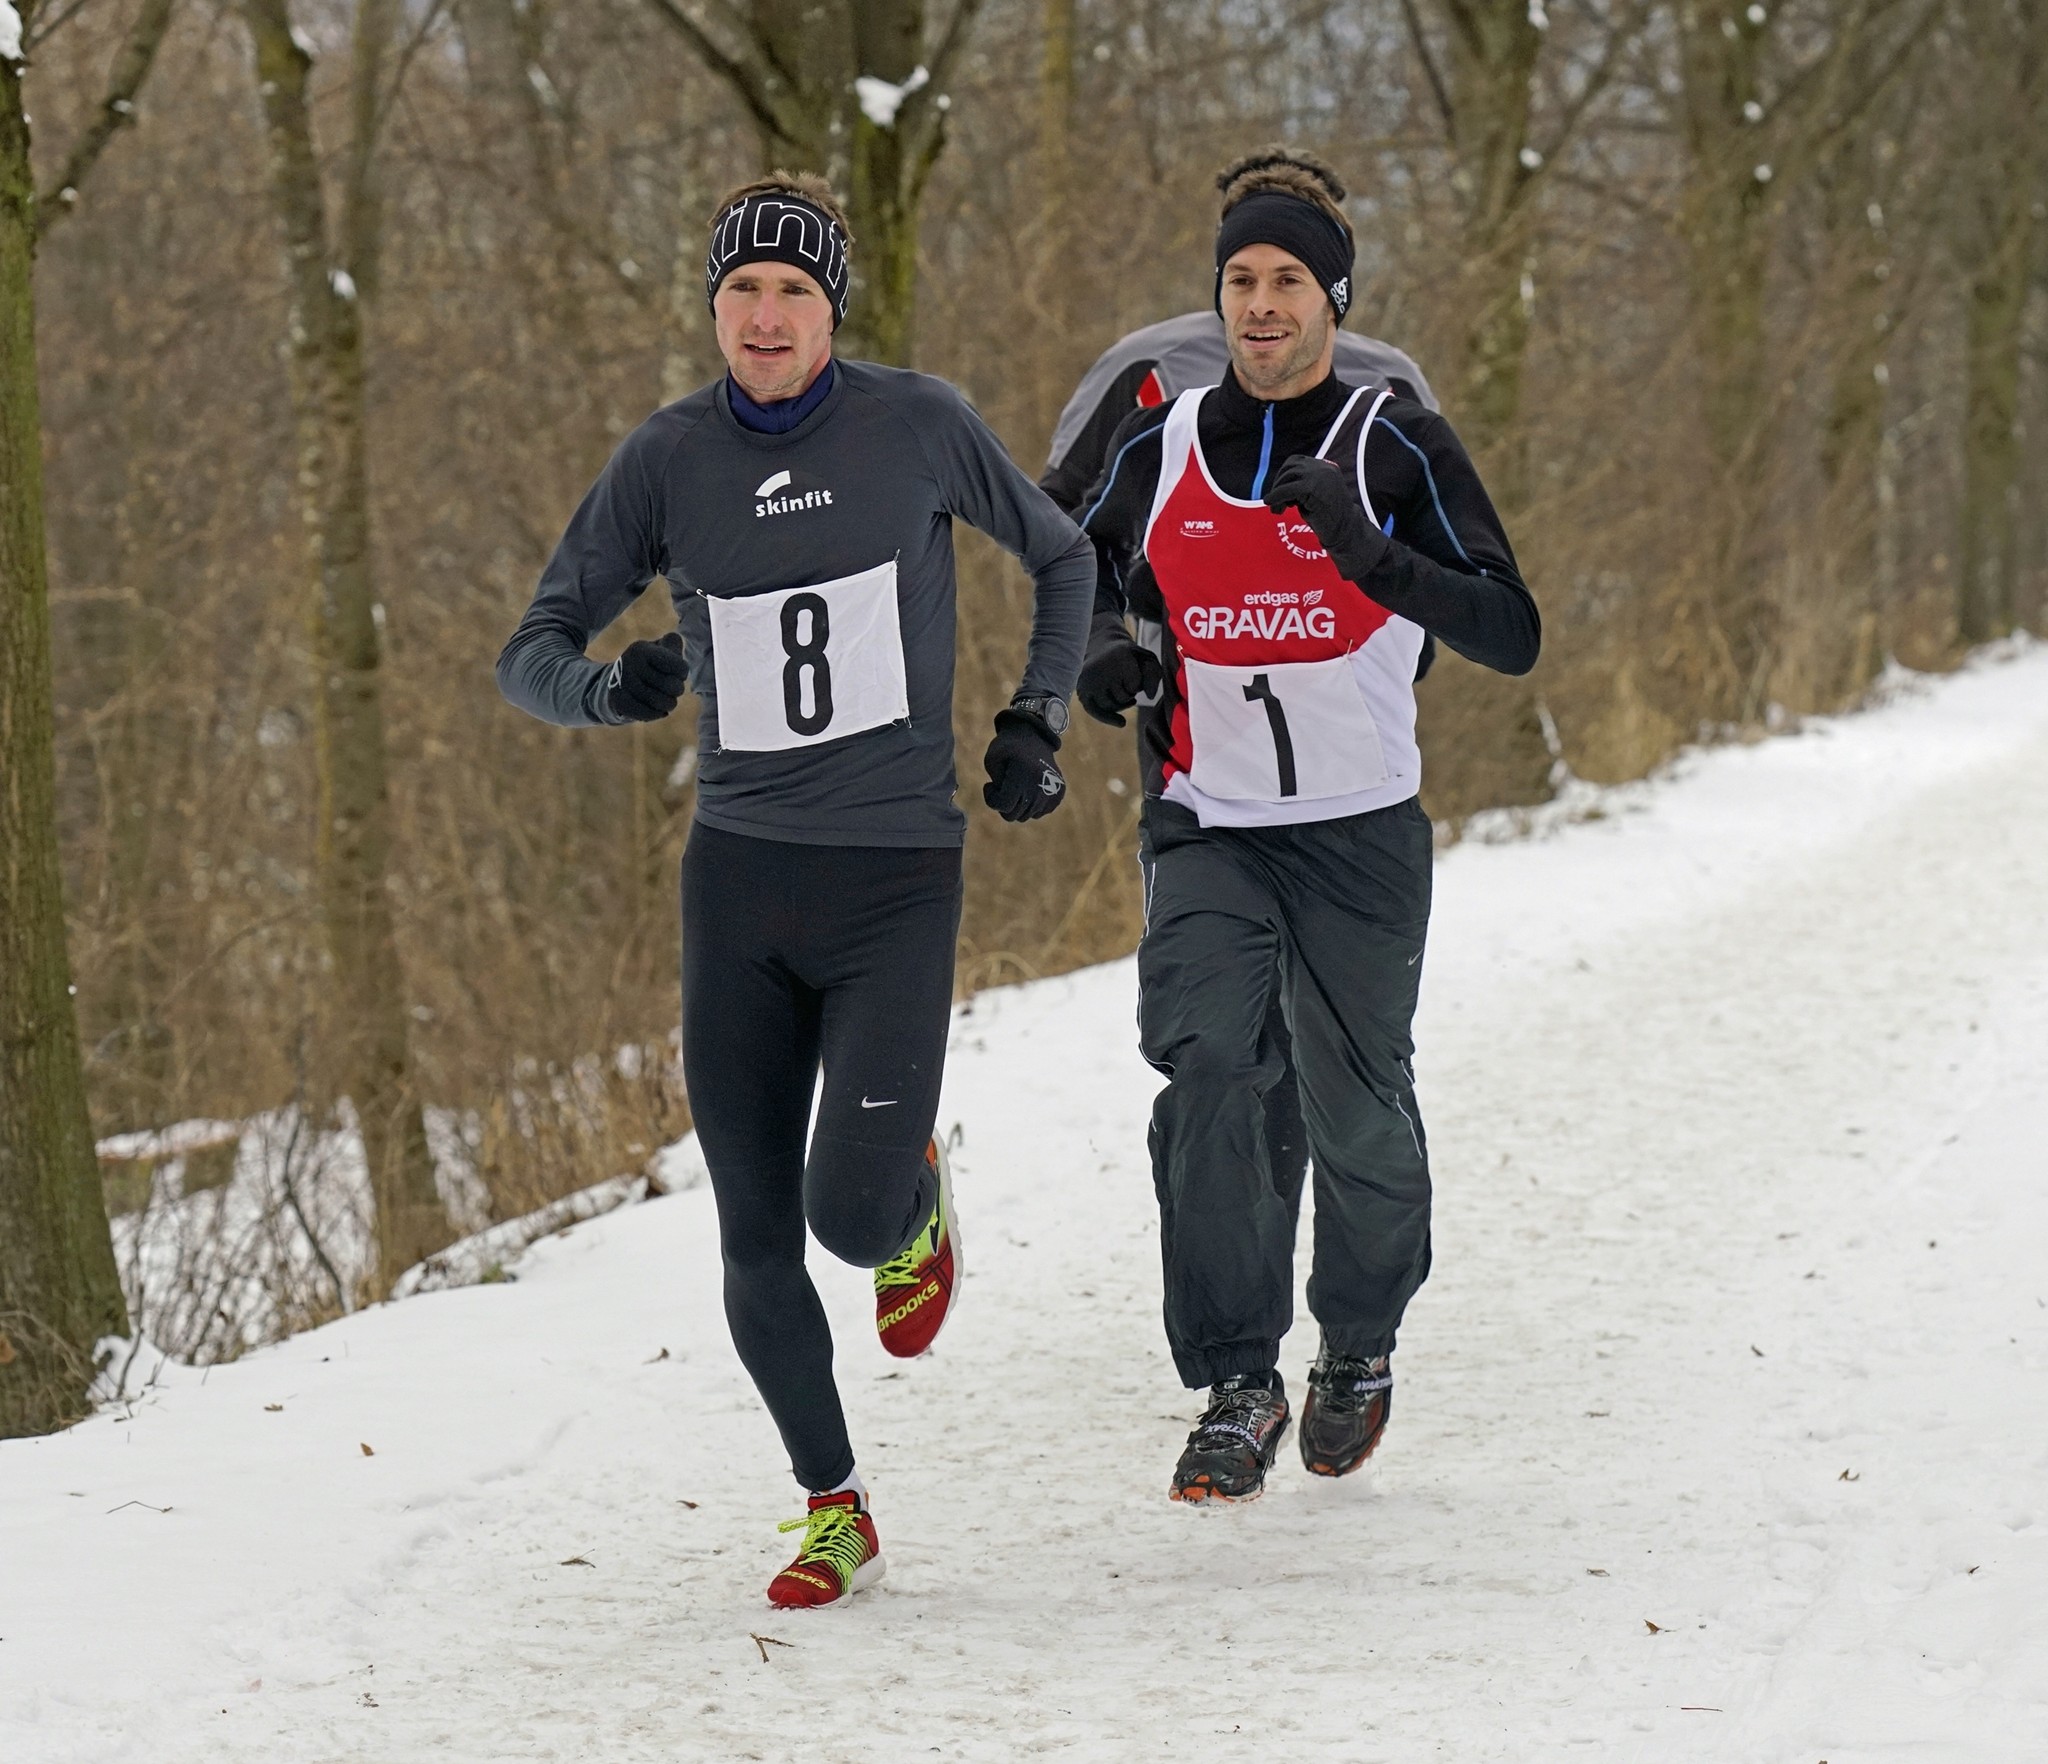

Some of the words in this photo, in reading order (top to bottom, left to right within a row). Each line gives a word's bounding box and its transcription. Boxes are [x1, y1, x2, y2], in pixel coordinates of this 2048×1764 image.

[755, 490, 833, 518] skinfit
[1277, 522, 1328, 560] RHEIN
[1243, 590, 1300, 606] erdgas
[1183, 605, 1336, 641] GRAVAG
[779, 592, 834, 736] 8
[1242, 673, 1298, 797] 1
[878, 1280, 940, 1333] BROOKS
